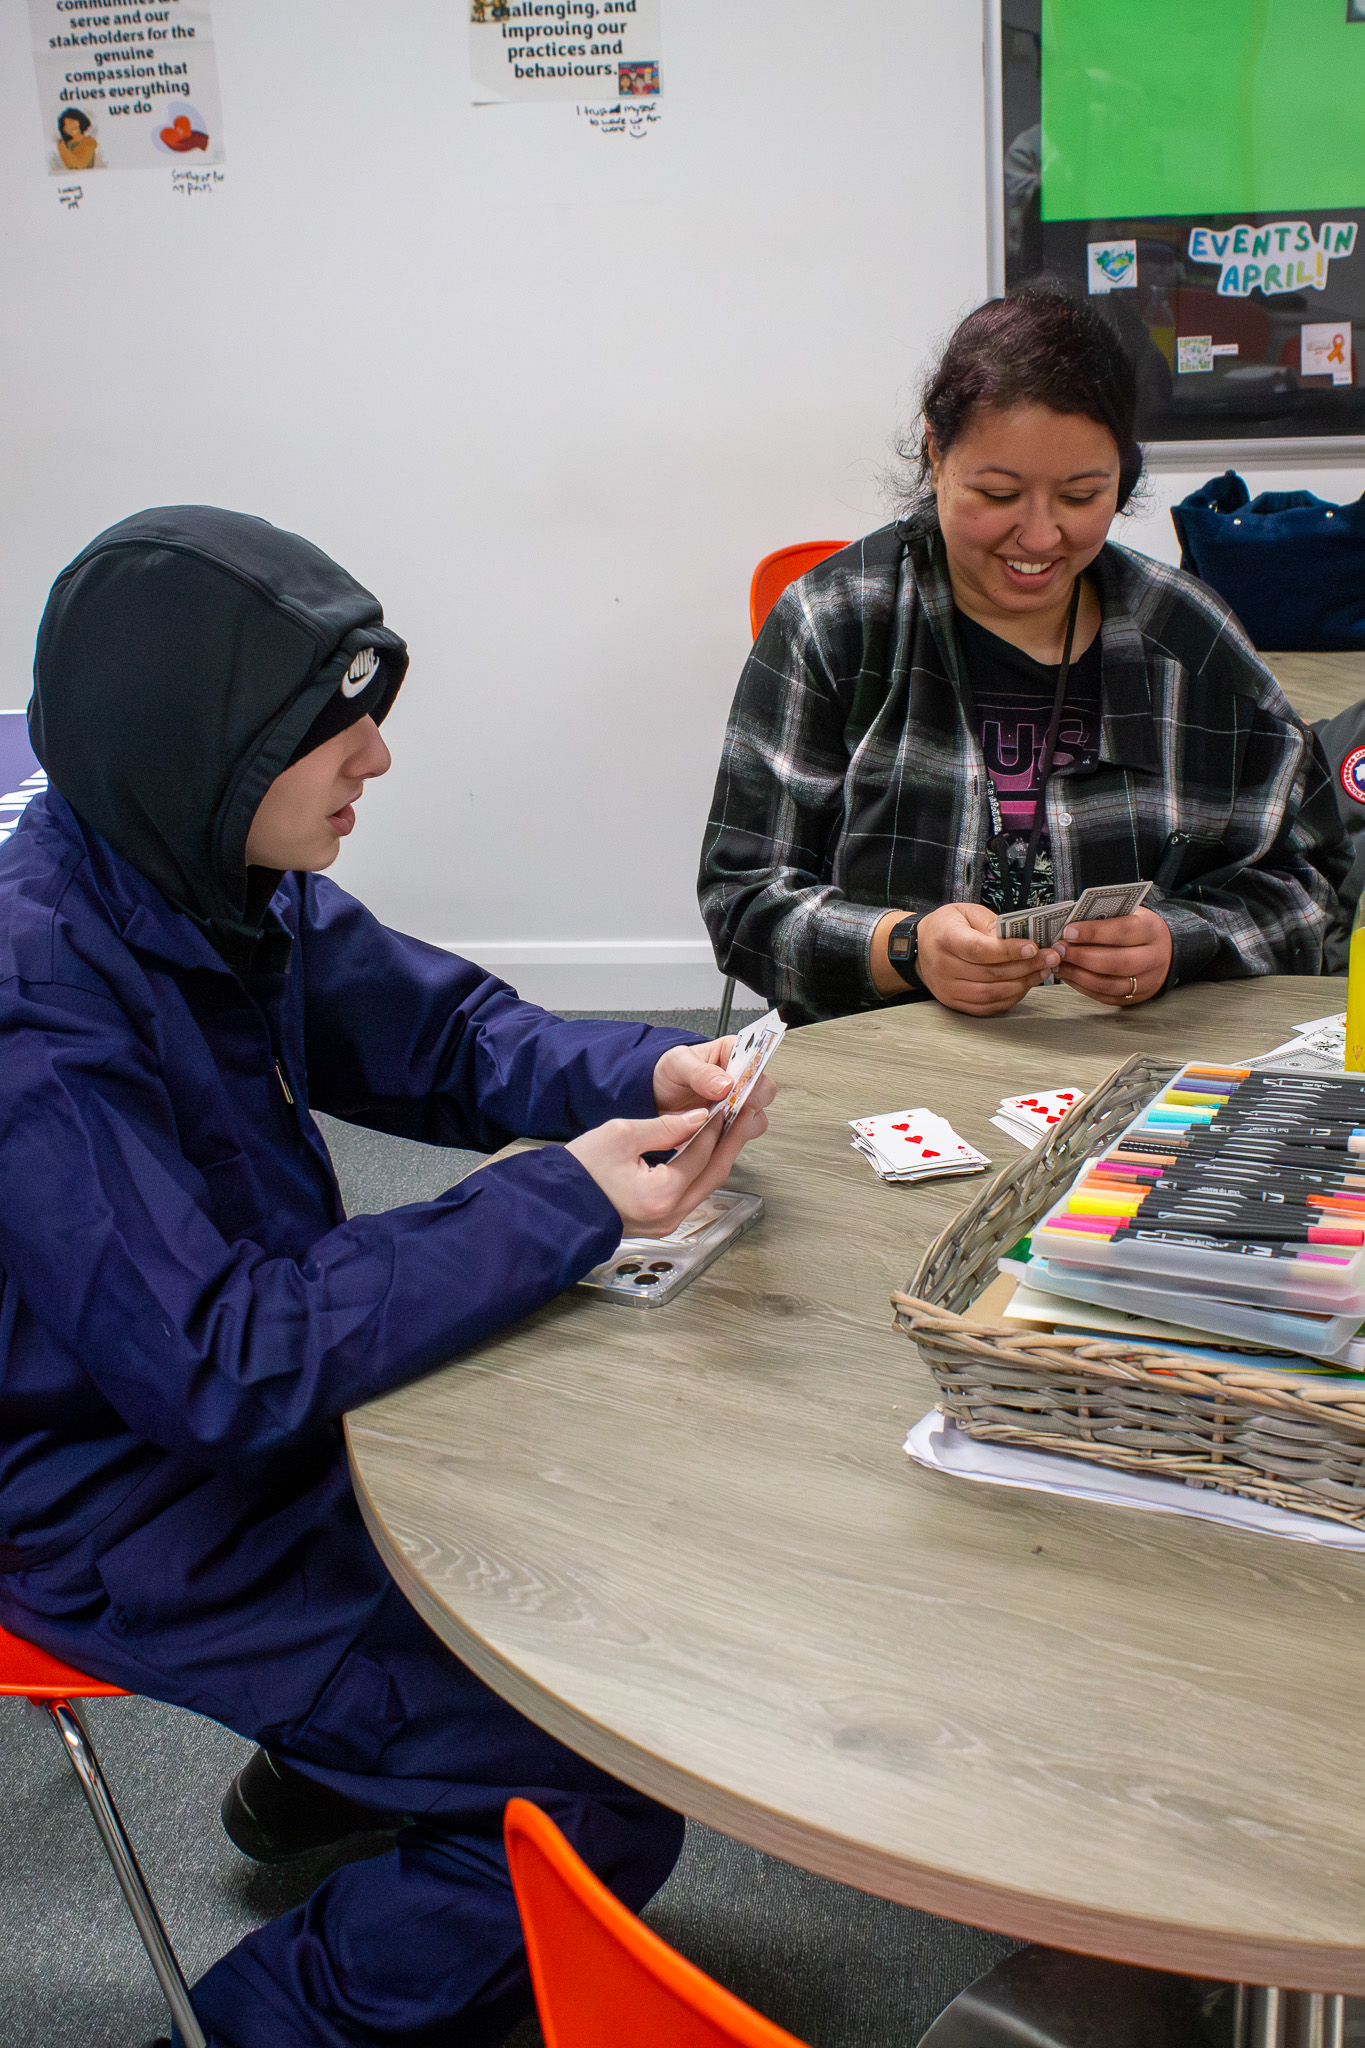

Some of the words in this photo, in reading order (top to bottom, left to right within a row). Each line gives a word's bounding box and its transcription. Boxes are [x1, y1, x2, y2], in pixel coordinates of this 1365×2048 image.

[604, 0, 637, 13] and
[70, 14, 110, 28] serve
[114, 10, 142, 25] and
[145, 10, 170, 22] our
[49, 30, 144, 48] stakeholders
[147, 27, 169, 40] for
[171, 25, 195, 38] the
[502, 20, 593, 41] improving
[598, 21, 628, 35] our
[94, 47, 155, 66] genuine
[508, 42, 586, 63] practices
[590, 40, 623, 56] and
[65, 65, 155, 84] compassion
[158, 62, 188, 75] that
[514, 62, 618, 79] behaviours.
[59, 86, 105, 101] drives
[109, 80, 190, 99] everything
[109, 103, 130, 115] we
[133, 101, 152, 114] do
[1191, 224, 1311, 258] EVENTS
[1322, 225, 1354, 253] IN
[1221, 251, 1323, 292] APRIL!
